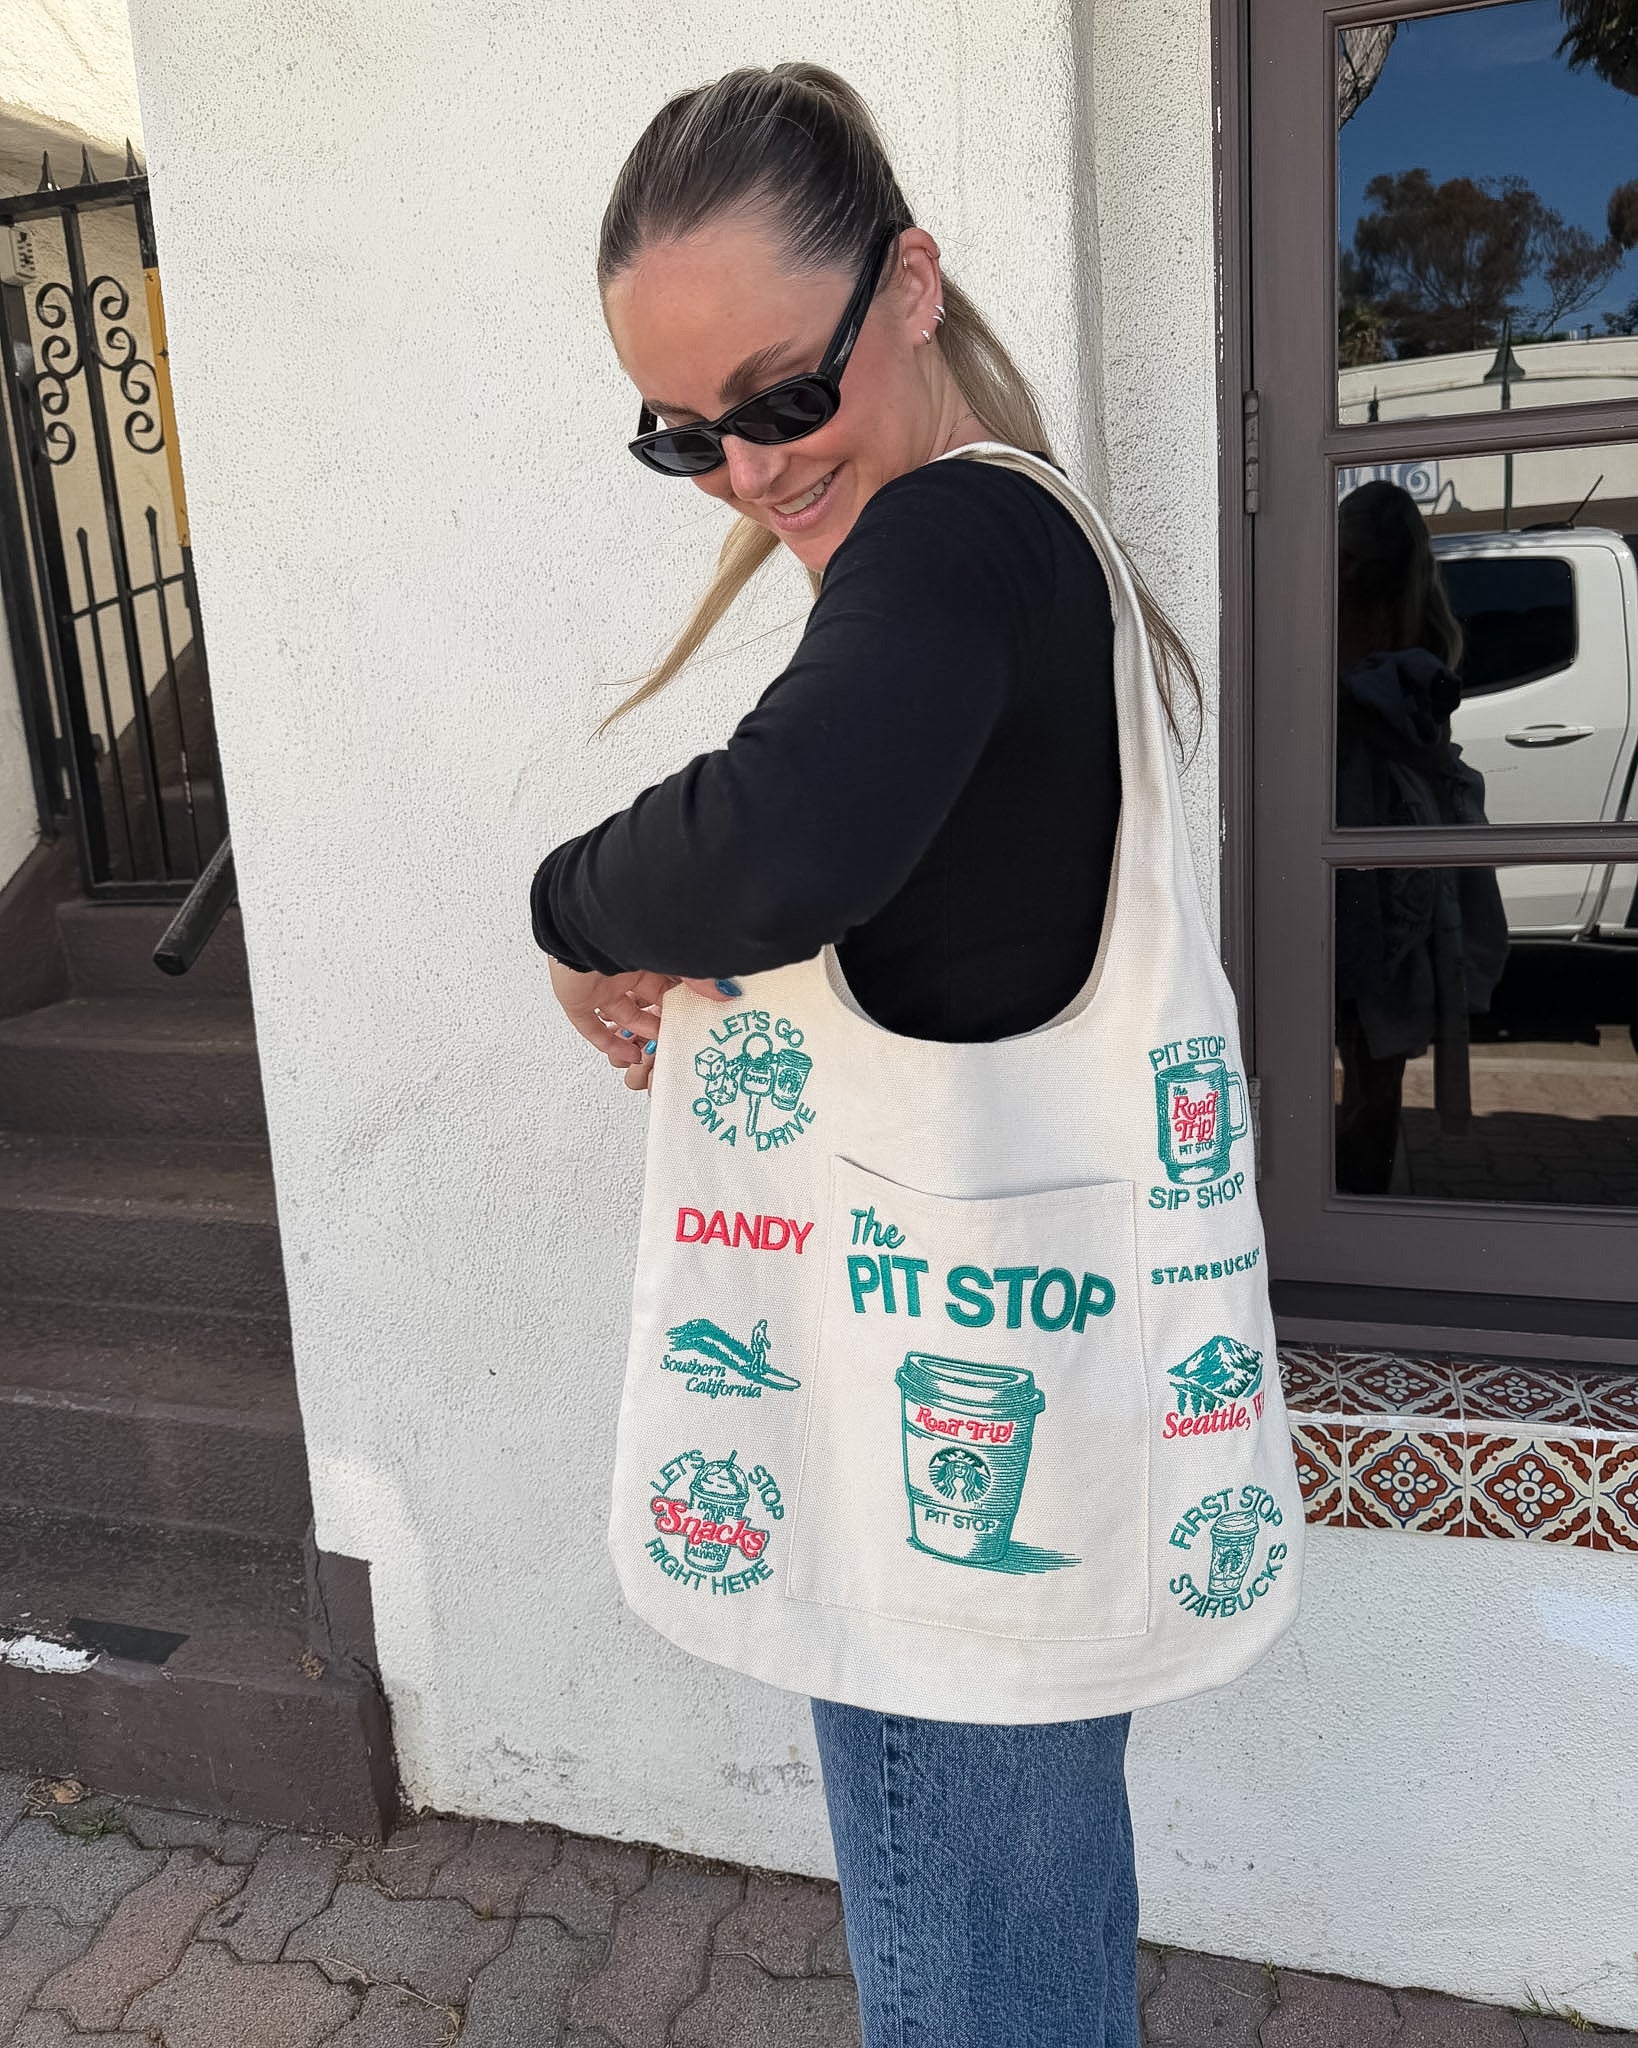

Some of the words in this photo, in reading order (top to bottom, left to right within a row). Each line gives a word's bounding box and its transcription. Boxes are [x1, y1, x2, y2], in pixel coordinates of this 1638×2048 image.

[709, 1010, 770, 1045] LET'S
[775, 1018, 804, 1048] GO
[1148, 1041, 1182, 1071] PIT
[1186, 1036, 1226, 1060] STOP
[692, 1098, 724, 1133] ON
[719, 1125, 737, 1147] A
[756, 1102, 816, 1151] DRIVE
[1172, 1091, 1219, 1120] Road
[1148, 1186, 1190, 1210] SIP
[1196, 1171, 1245, 1209] SHOP
[675, 1207, 815, 1254] DANDY
[850, 1206, 905, 1249] The
[847, 1254, 929, 1317] PIT
[945, 1265, 1116, 1333] STOP
[660, 1354, 726, 1378] Southern
[685, 1377, 762, 1399] California
[915, 1406, 964, 1436] Road
[1163, 1401, 1251, 1439] Seattle,
[650, 1449, 706, 1494] LET'S
[748, 1465, 784, 1520] STOP
[652, 1497, 766, 1559] Snacks
[924, 1508, 950, 1525] PIT
[953, 1515, 996, 1532] STOP
[1169, 1488, 1233, 1550] FIRST
[1239, 1485, 1283, 1526] STOP
[645, 1537, 707, 1590] RIGHT
[711, 1558, 774, 1595] HERE
[1169, 1542, 1288, 1618] STARBUCKS
